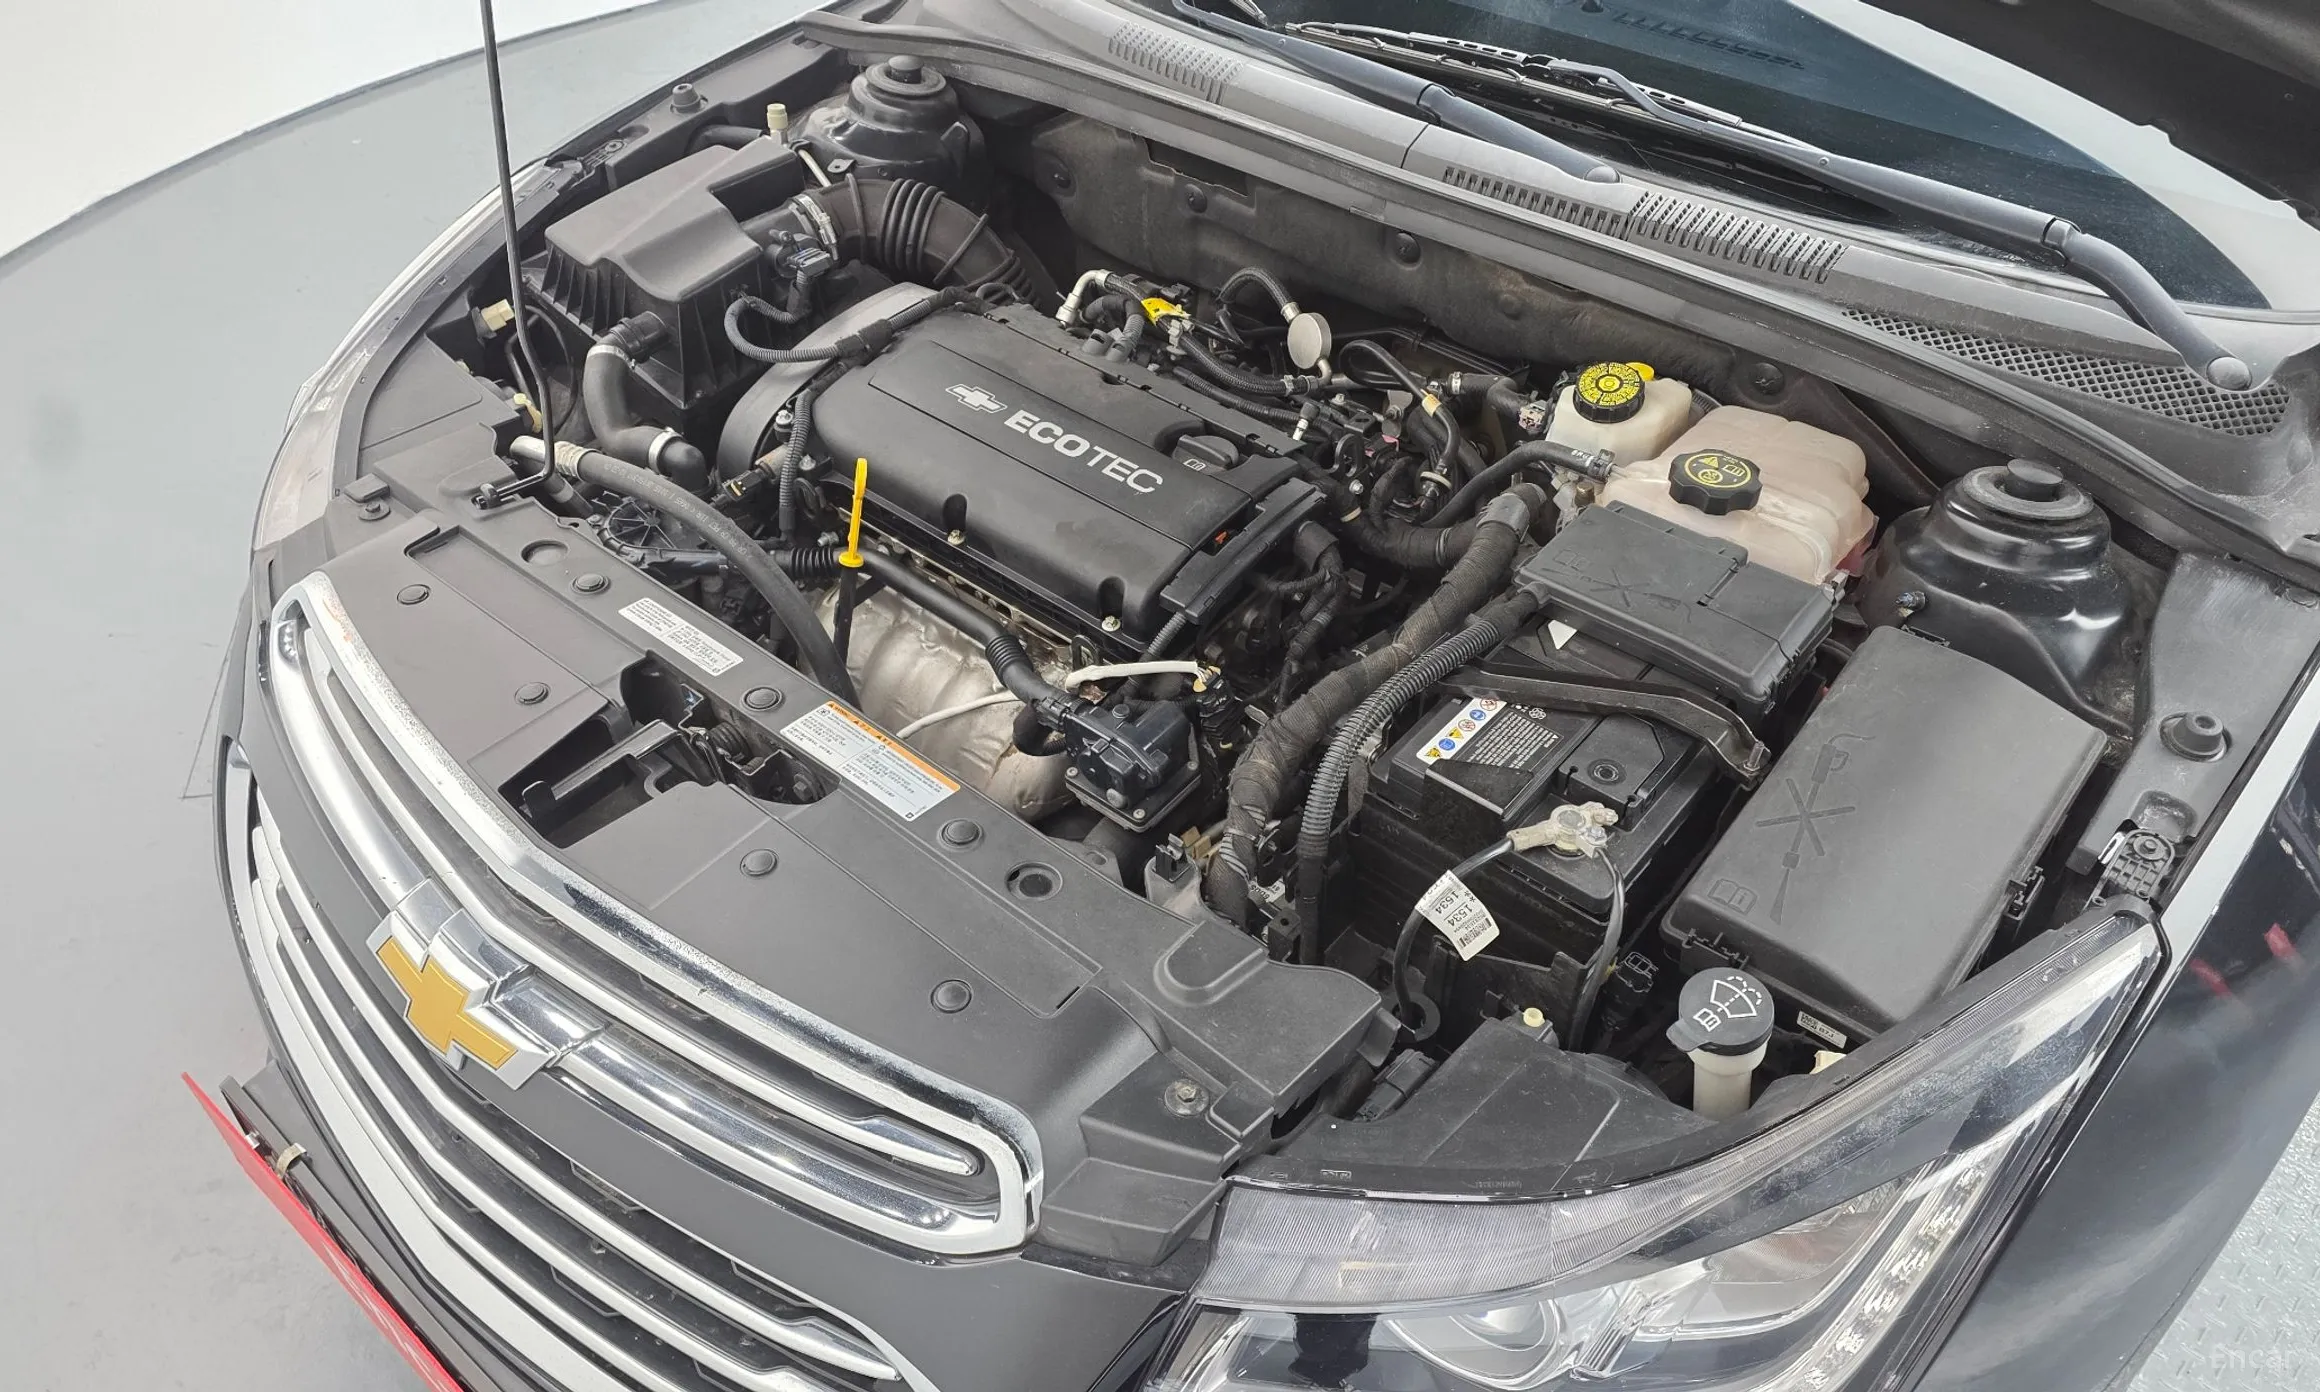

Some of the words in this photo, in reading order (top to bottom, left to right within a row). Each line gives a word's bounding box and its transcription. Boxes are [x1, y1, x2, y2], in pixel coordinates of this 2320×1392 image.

[1003, 409, 1164, 494] ECOTEC
[1435, 890, 1459, 914] 1534
[1447, 904, 1473, 927] 1534
